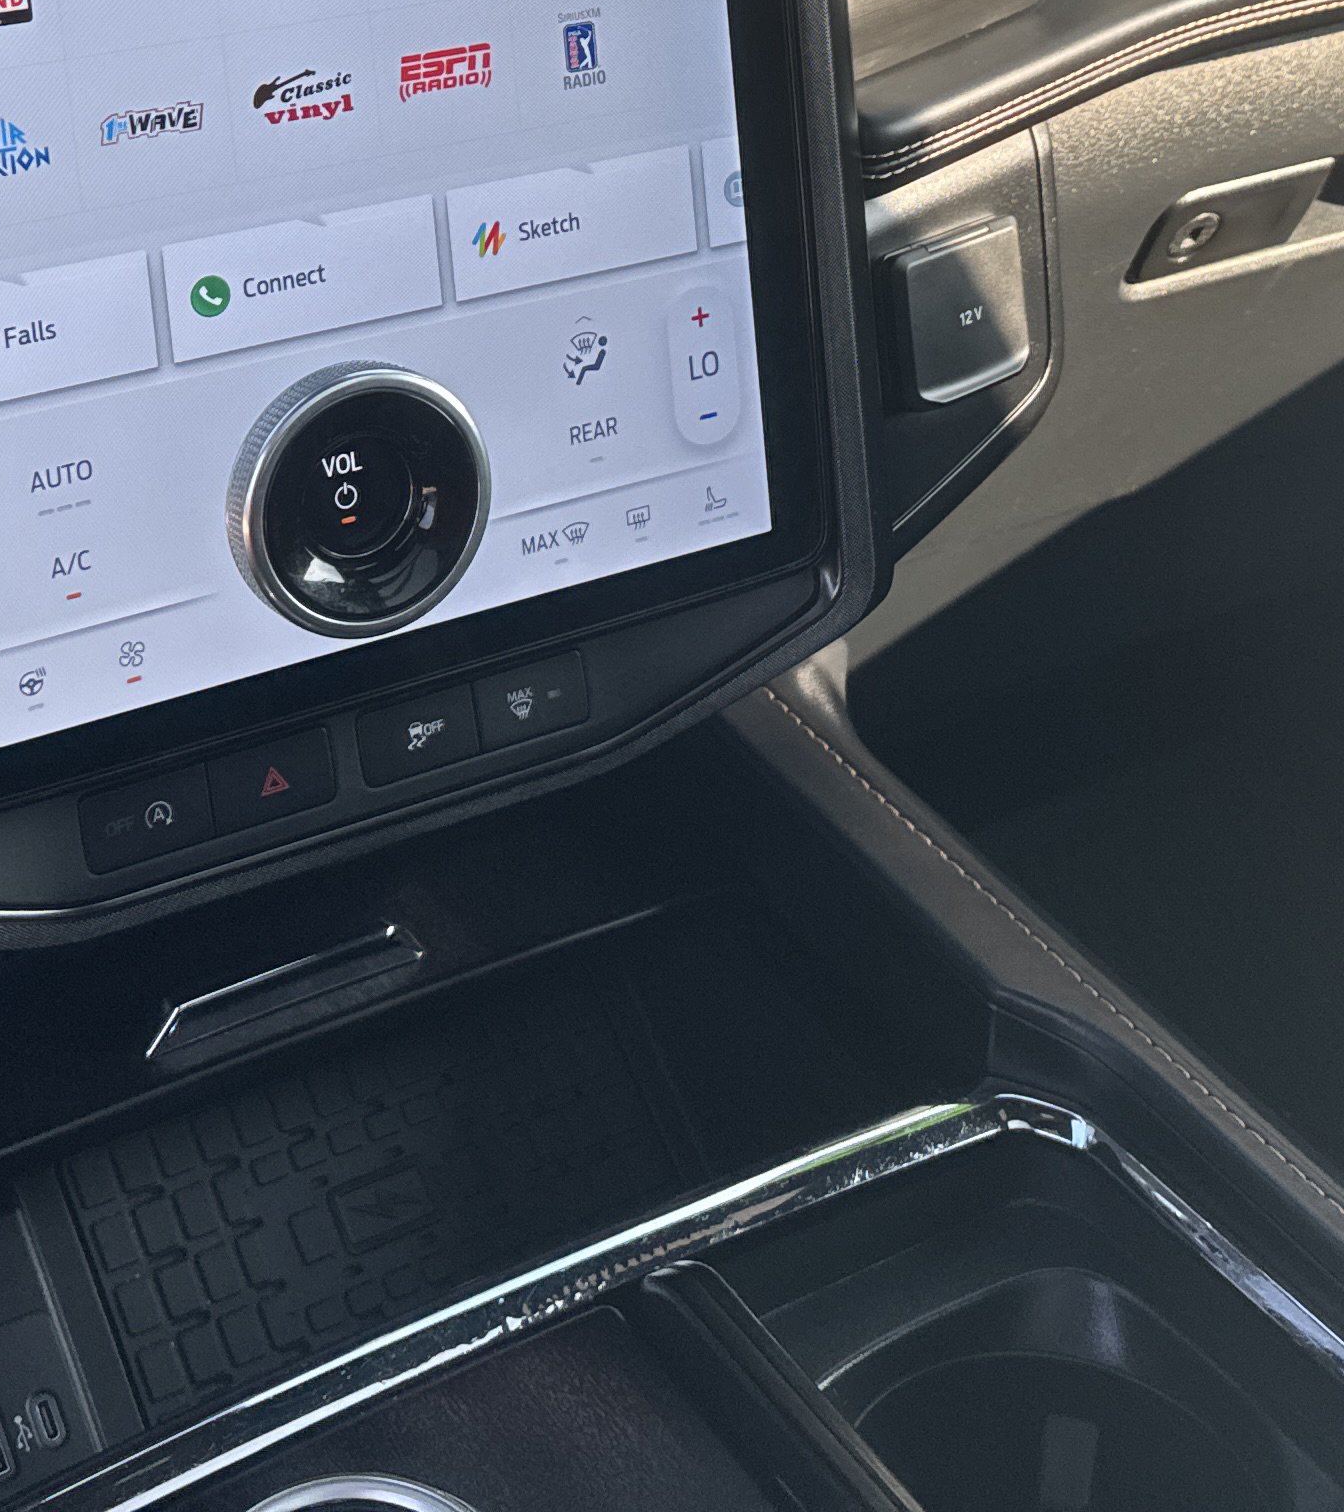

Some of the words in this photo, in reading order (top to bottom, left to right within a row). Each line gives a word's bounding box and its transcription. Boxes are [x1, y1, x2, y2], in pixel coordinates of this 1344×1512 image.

[400, 42, 491, 83] ESPN
[279, 70, 353, 104] Classic
[412, 72, 479, 95] RADIO
[563, 69, 606, 91] RADIO
[128, 107, 198, 135] WAVE
[263, 93, 354, 125] vinyl
[518, 212, 581, 242] Sketch
[242, 263, 327, 298] Connect
[3, 320, 57, 350] Falls
[688, 350, 720, 381] LO
[568, 417, 619, 446] REAR
[30, 459, 94, 493] AUTO
[321, 450, 364, 479] VOL
[520, 530, 561, 557] MAX
[50, 549, 92, 580] A/C
[506, 686, 534, 704] MAX
[423, 718, 445, 737] OFF
